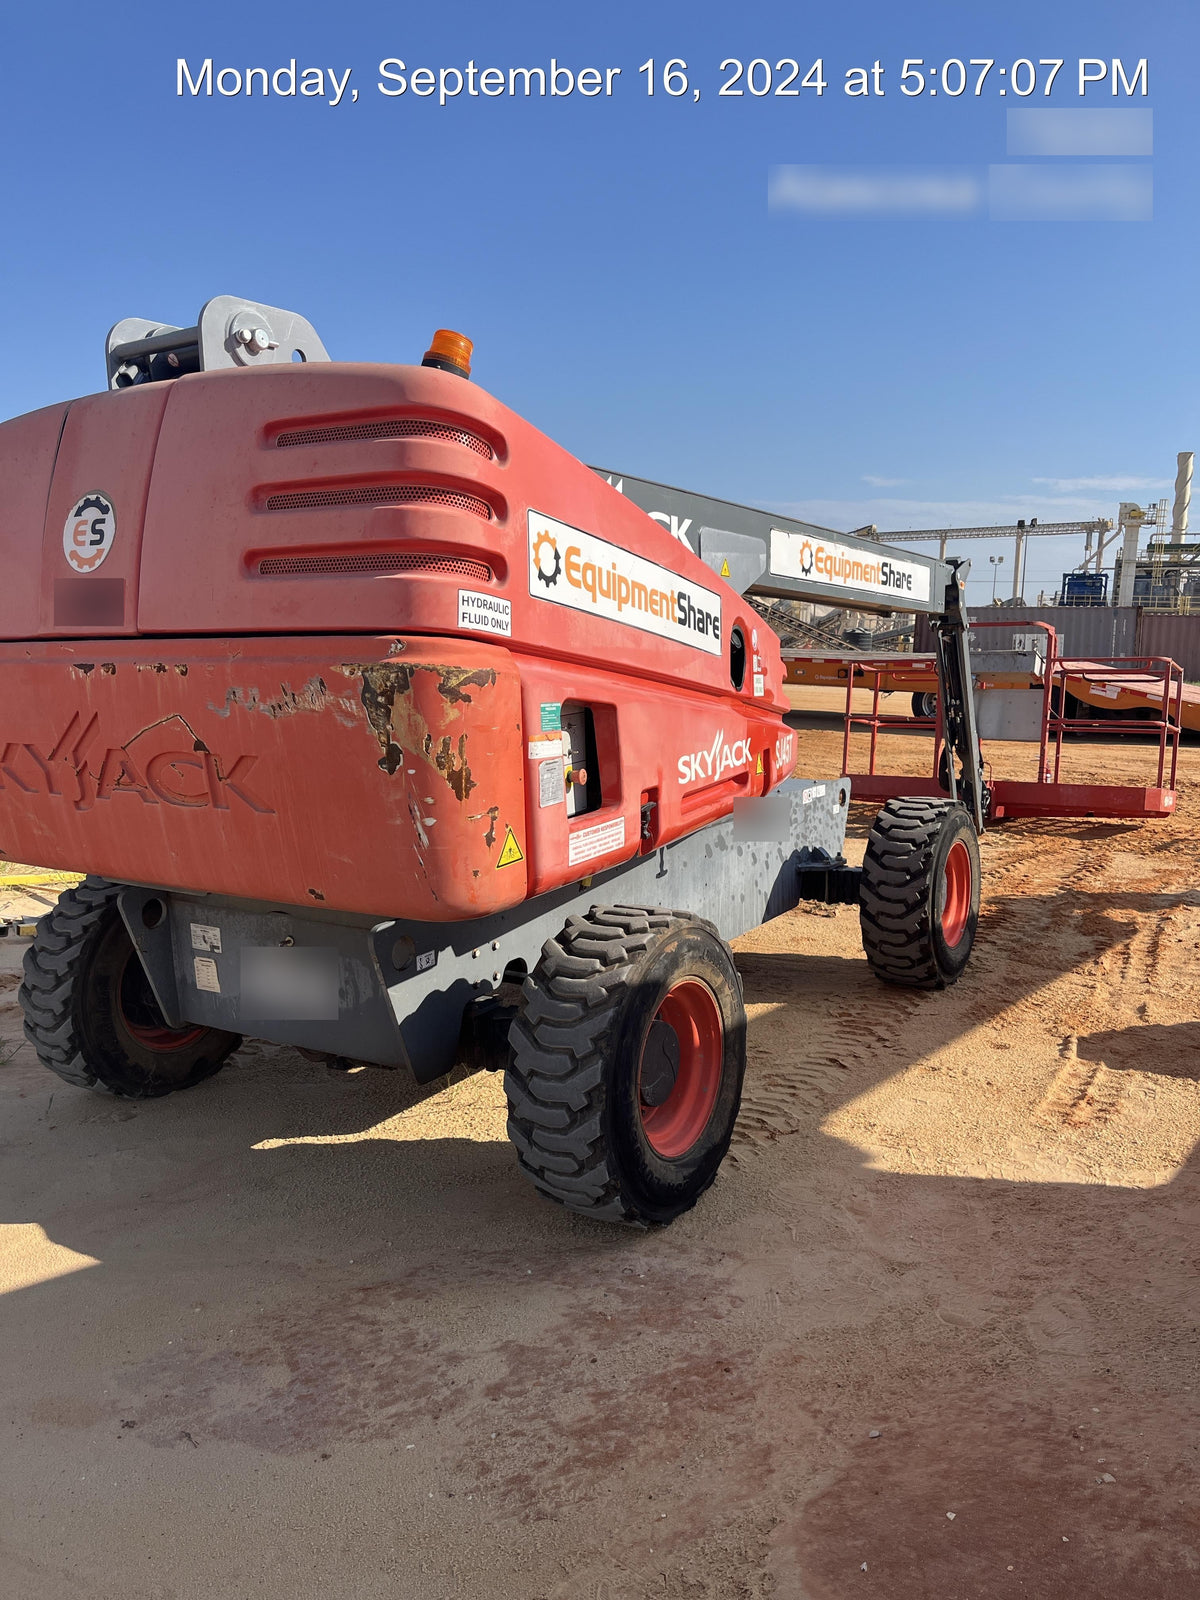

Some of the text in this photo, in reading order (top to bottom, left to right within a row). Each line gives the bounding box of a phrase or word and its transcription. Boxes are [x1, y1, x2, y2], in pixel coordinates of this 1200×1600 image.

[72, 517, 107, 547] ES
[814, 546, 913, 592] EquipmentShare
[461, 595, 510, 616] HYDRAULIC
[565, 545, 720, 640] EquipmentShare
[461, 612, 510, 632] FLUID ONLY
[677, 728, 753, 785] SKYJACK
